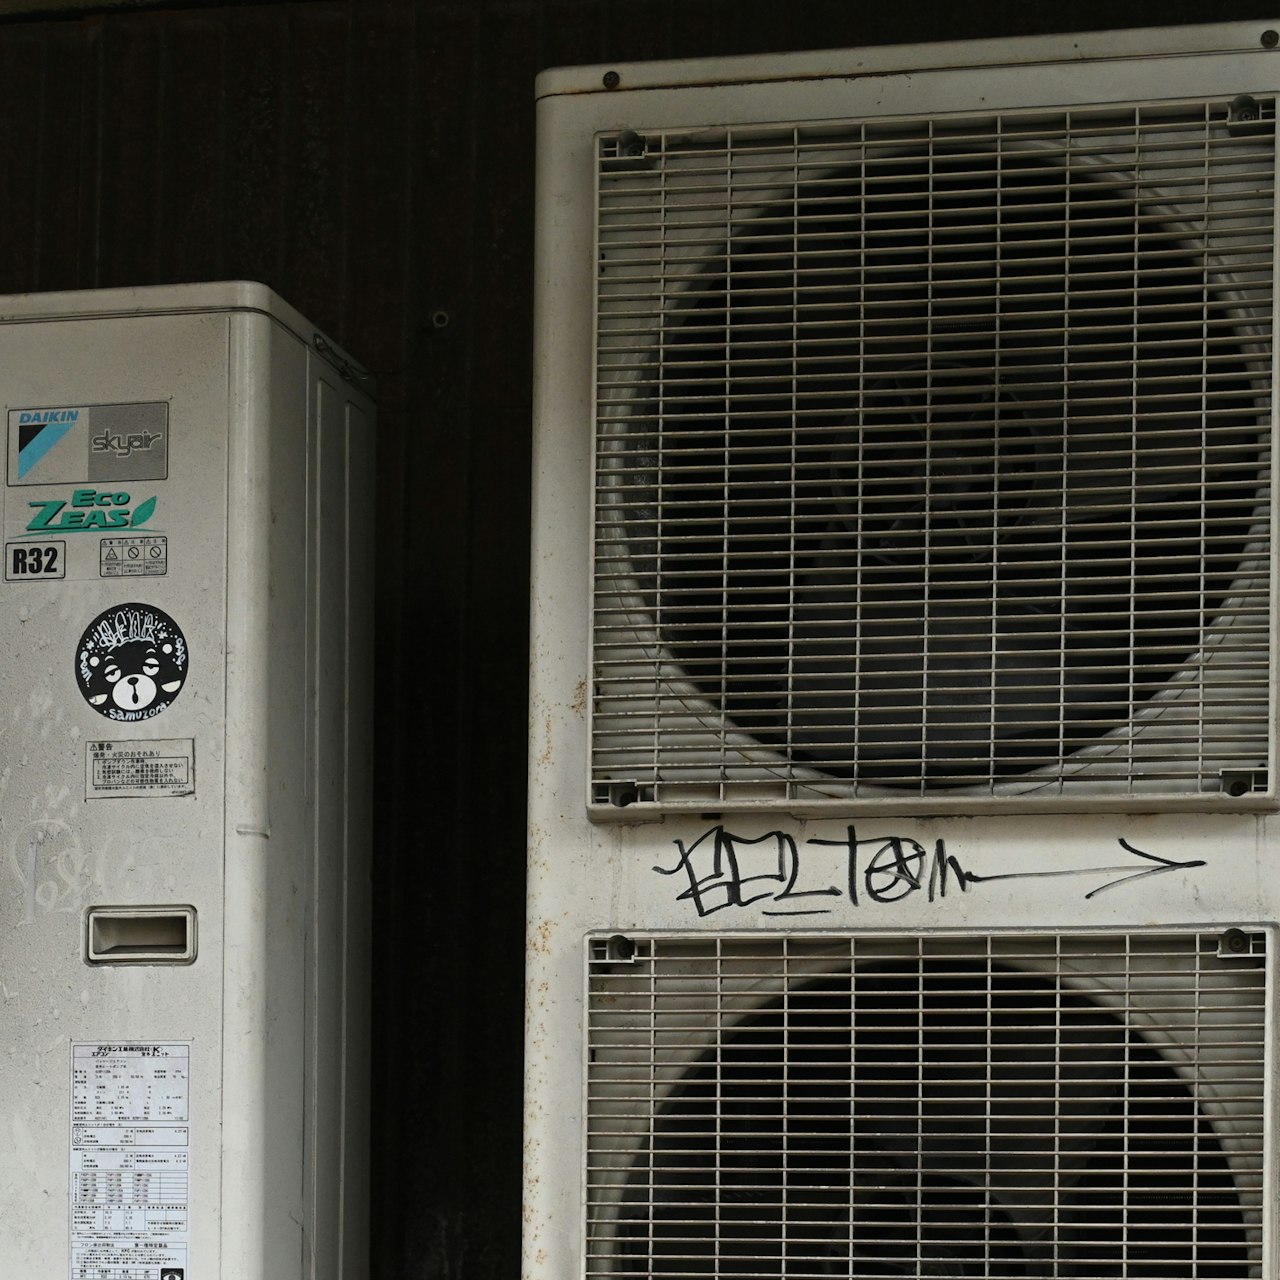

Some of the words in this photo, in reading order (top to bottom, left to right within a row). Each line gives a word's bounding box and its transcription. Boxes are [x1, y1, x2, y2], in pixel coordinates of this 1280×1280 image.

[19, 410, 79, 423] DAIKIN
[91, 428, 162, 458] skyair
[12, 547, 58, 574] R32
